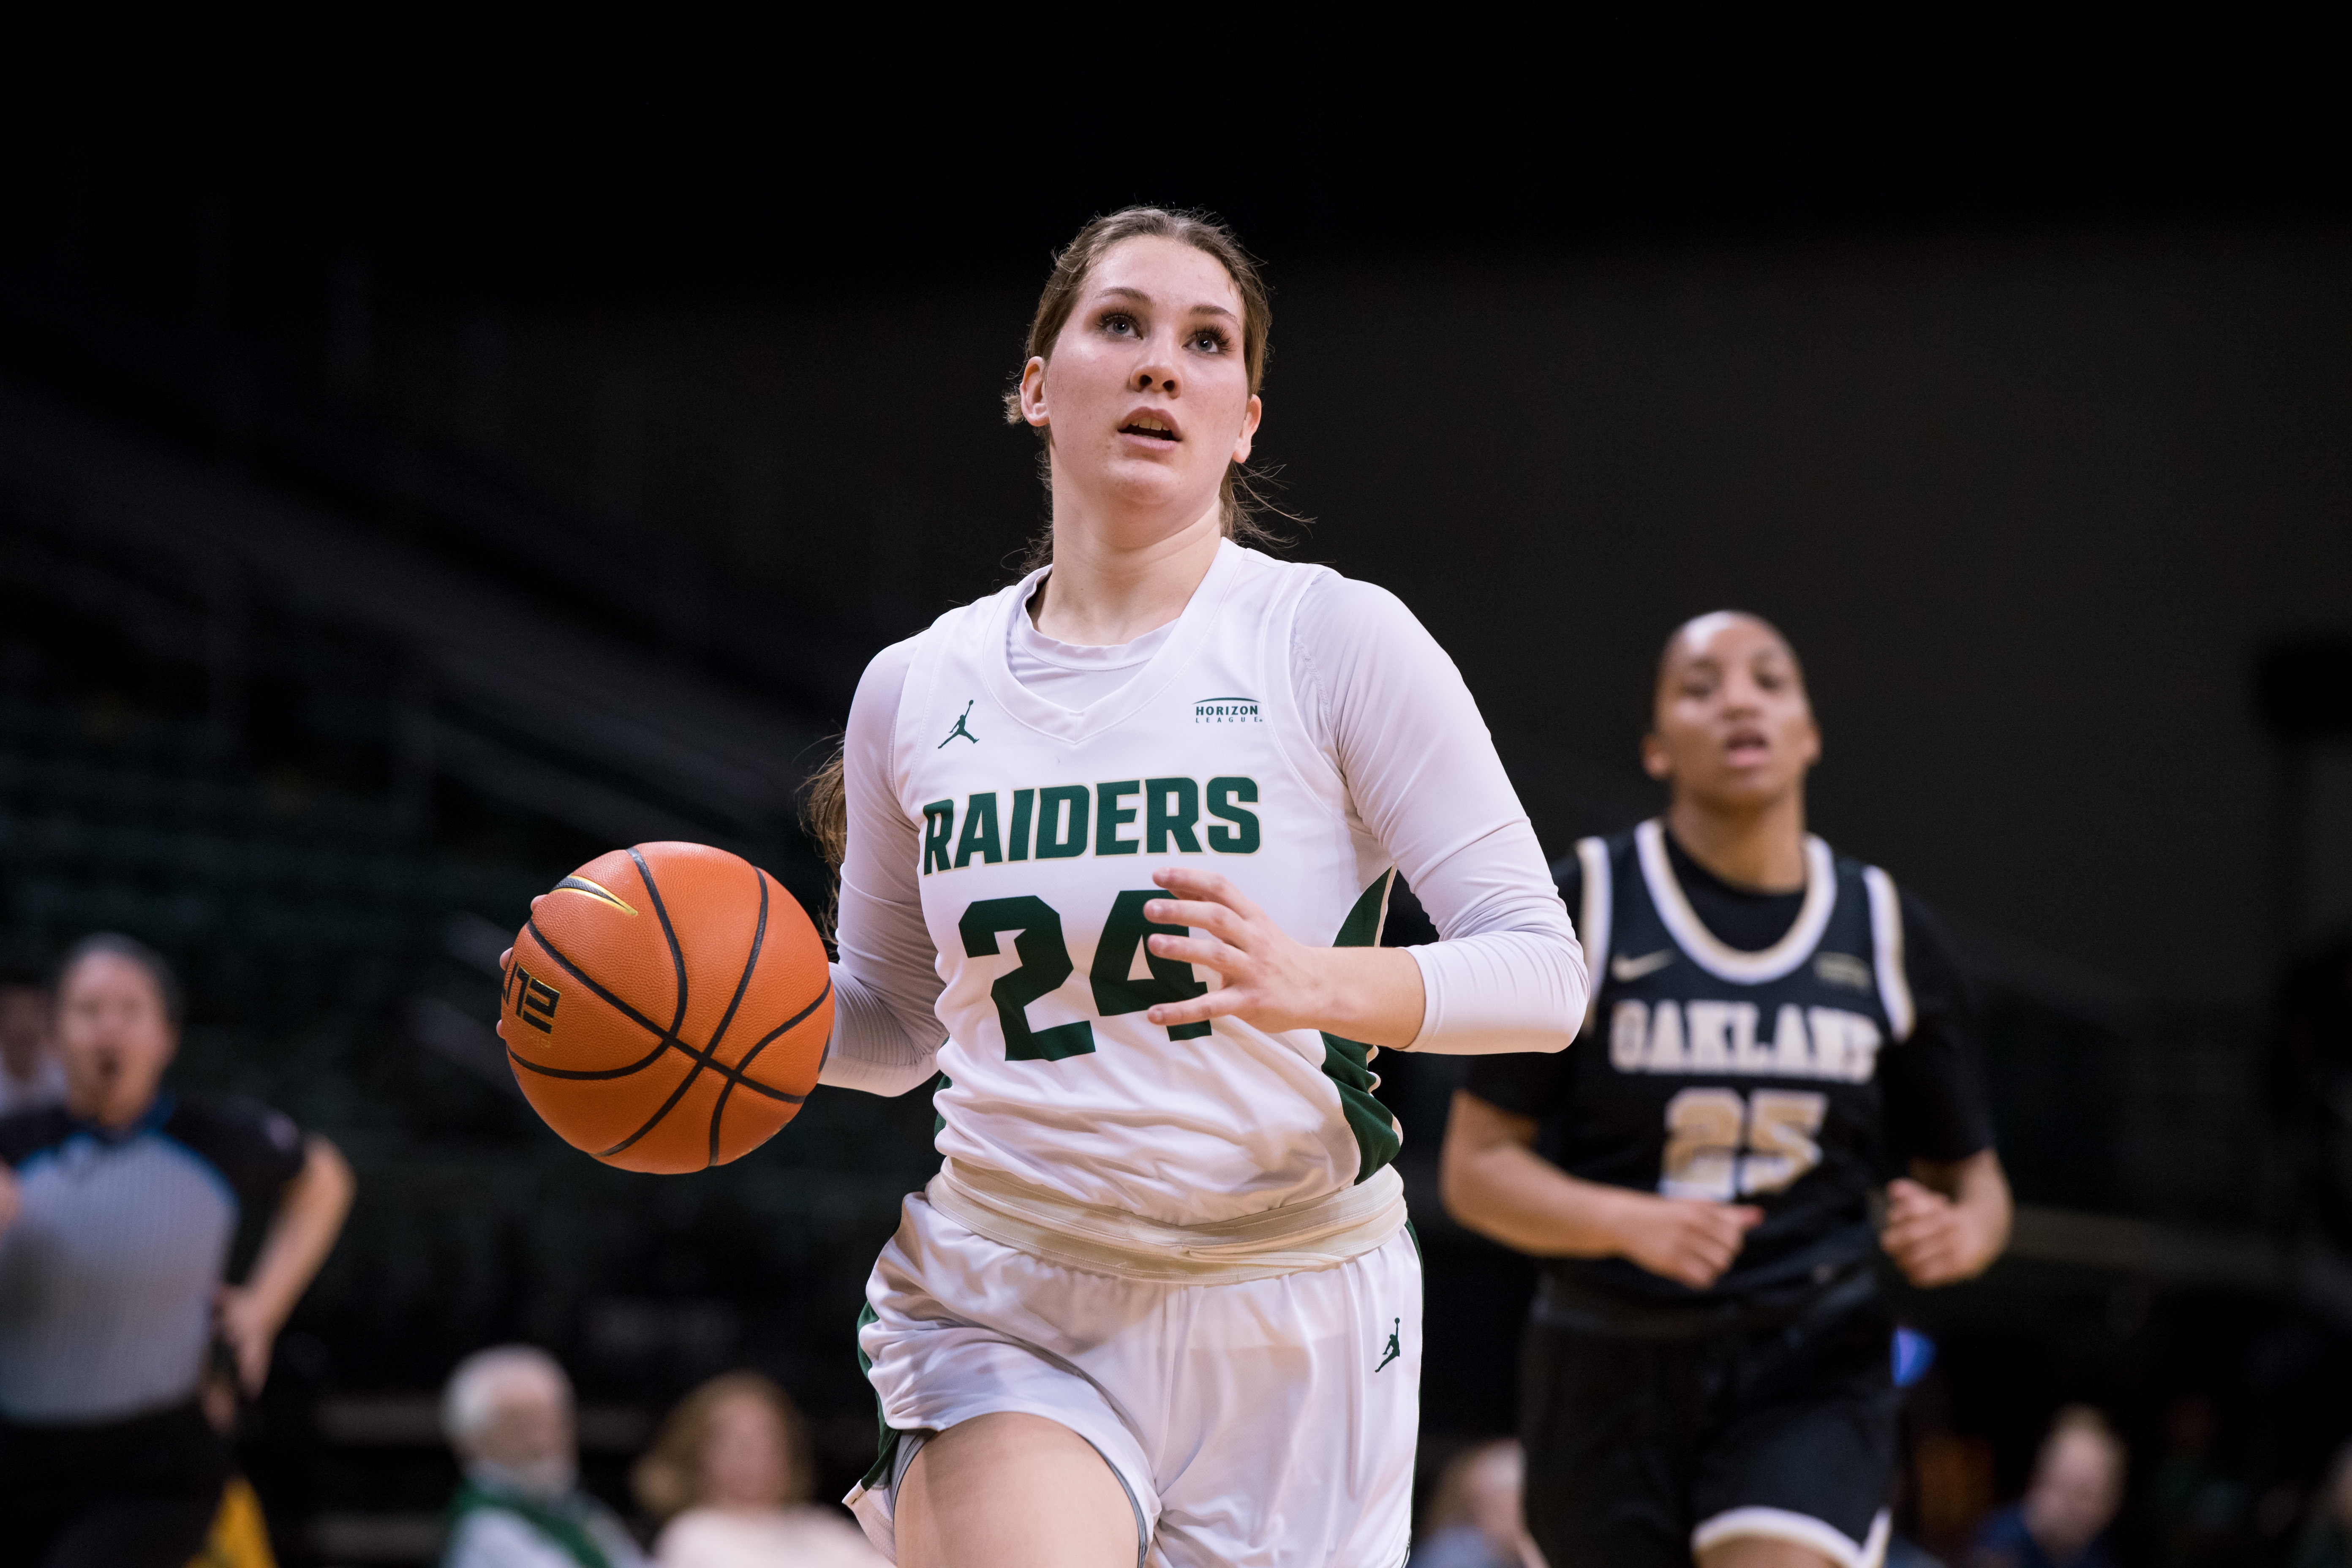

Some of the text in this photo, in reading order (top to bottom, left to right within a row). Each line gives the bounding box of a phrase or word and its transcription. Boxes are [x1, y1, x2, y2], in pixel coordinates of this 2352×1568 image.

[1196, 705, 1258, 716] HORIZON
[923, 775, 1261, 877] RAIDERS
[958, 890, 1212, 1062] 24
[1658, 1087, 1827, 1202] 25
